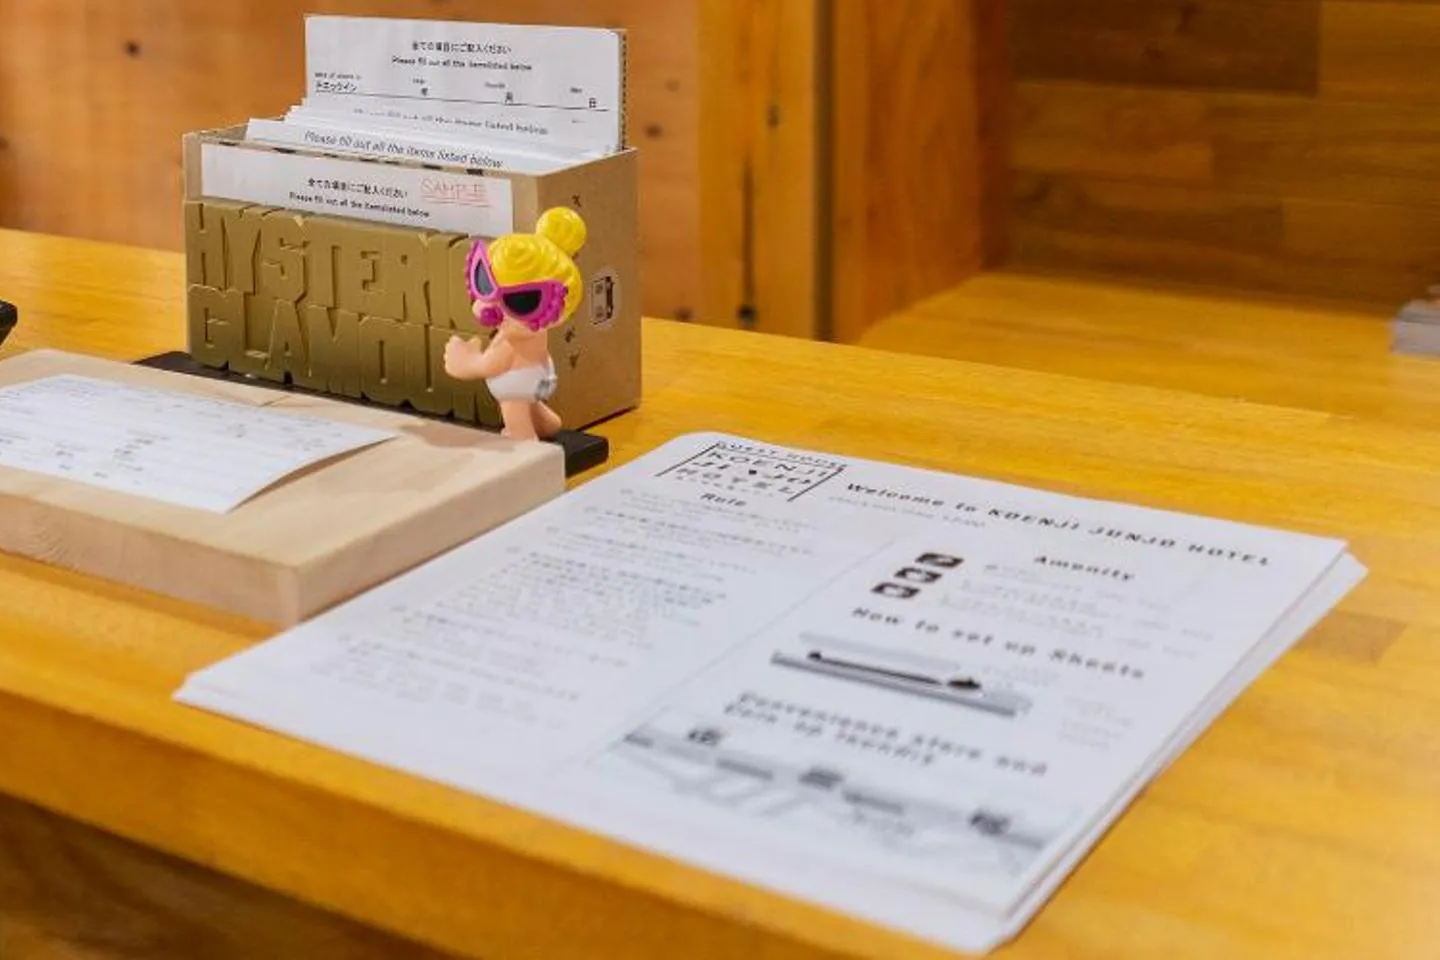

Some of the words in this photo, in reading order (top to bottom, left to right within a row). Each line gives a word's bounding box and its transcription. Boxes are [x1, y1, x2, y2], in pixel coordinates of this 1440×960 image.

[847, 482, 945, 507] Welcome
[988, 507, 1080, 531] KOENJI
[1188, 542, 1271, 567] HOTEL
[1034, 553, 1136, 581] Amenity
